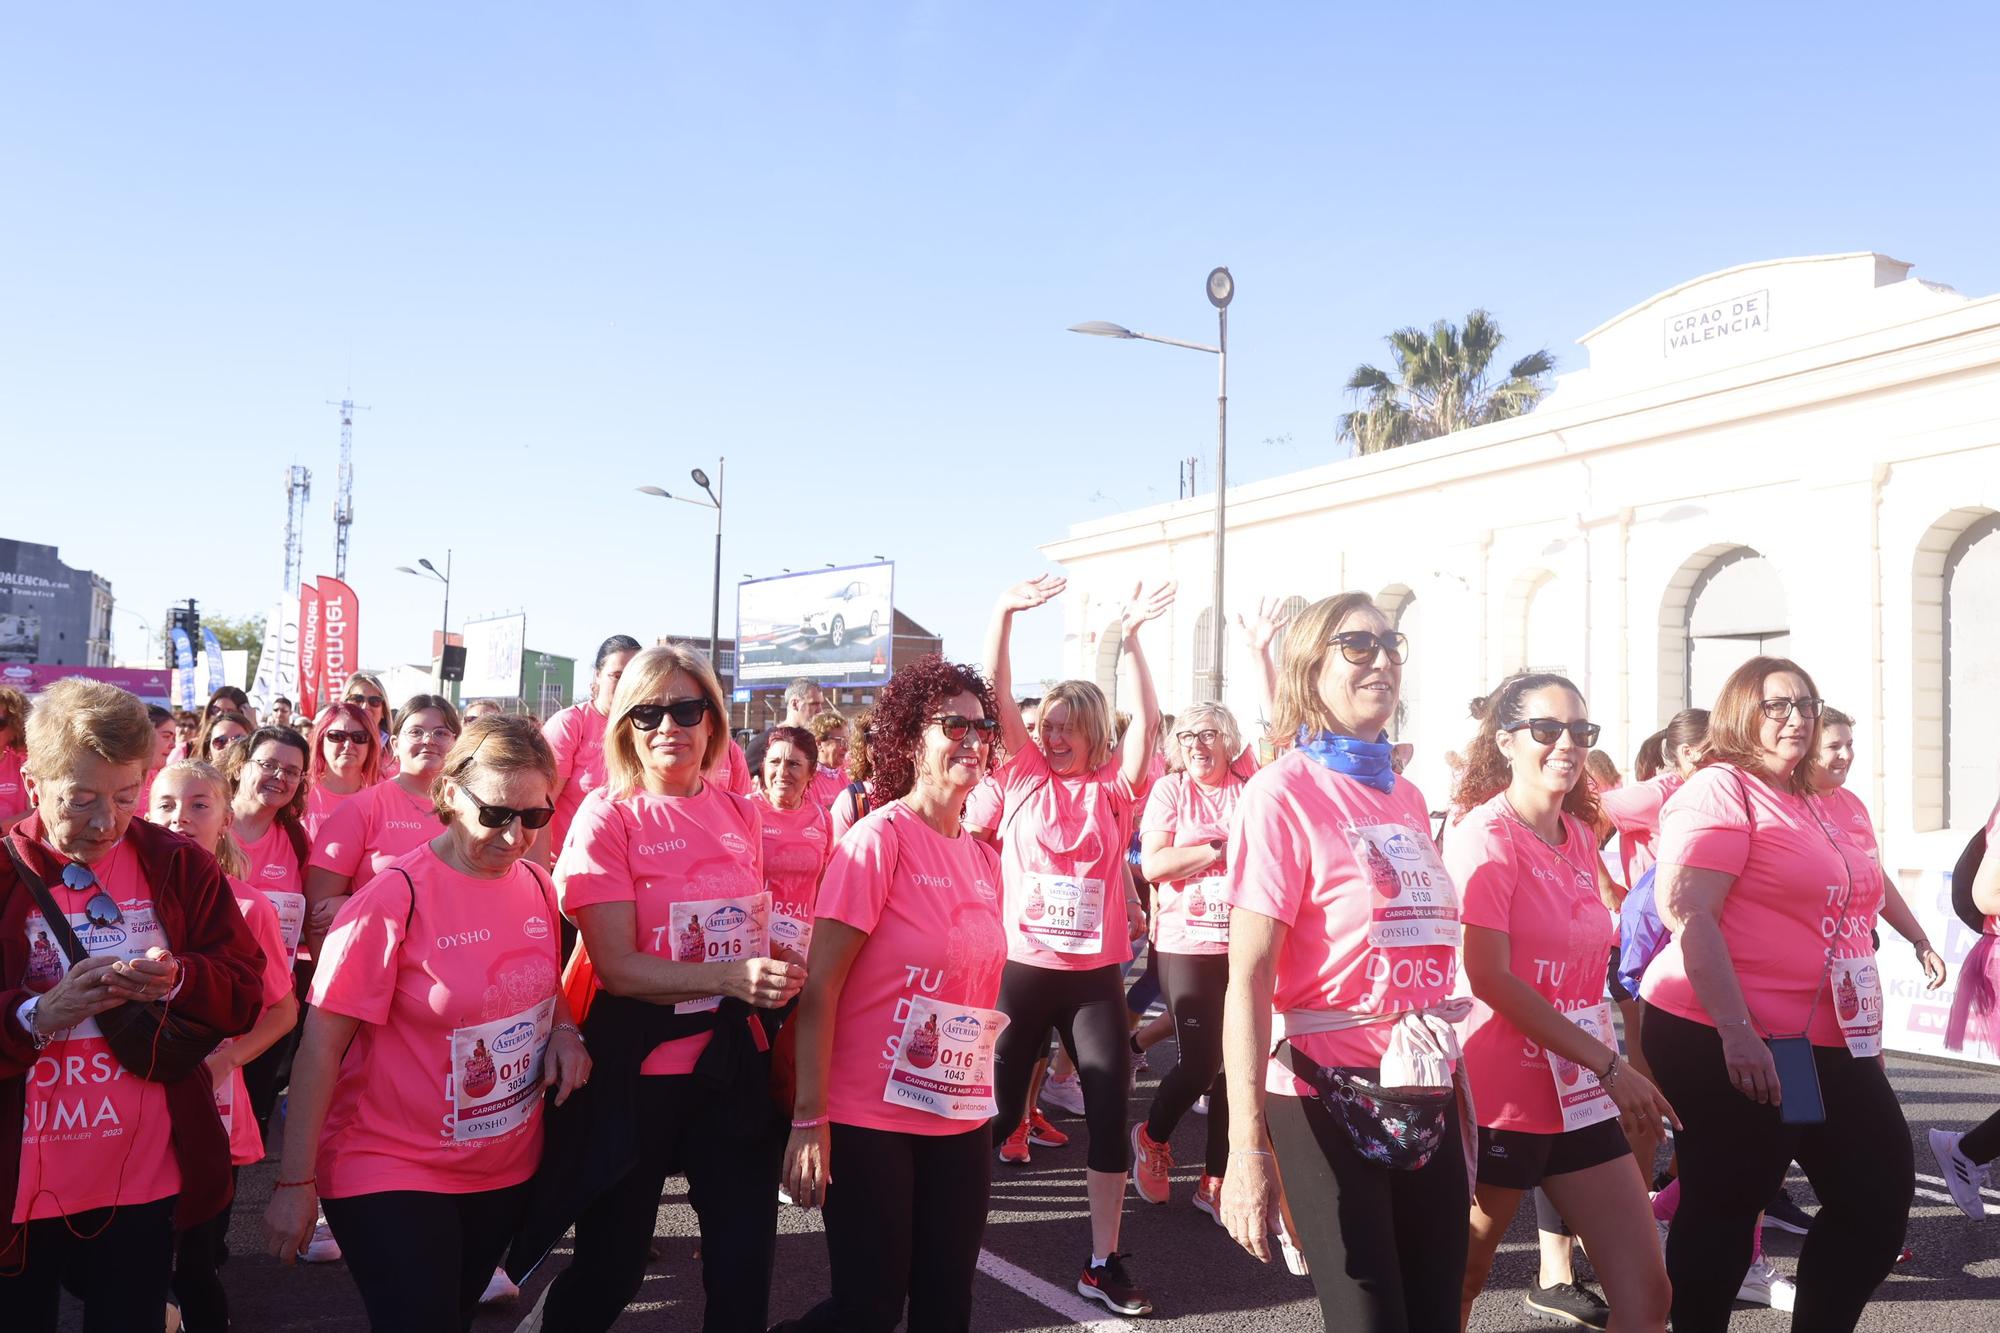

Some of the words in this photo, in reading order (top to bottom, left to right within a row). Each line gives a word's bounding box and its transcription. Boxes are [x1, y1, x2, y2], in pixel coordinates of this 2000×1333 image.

[1674, 310, 1722, 332] GRAO
[1732, 298, 1758, 316] DE
[1670, 315, 1761, 349] VALENCIA
[386, 821, 422, 830] OYSHO
[638, 838, 687, 855] OYSHO
[1401, 870, 1432, 888] 016
[1412, 891, 1432, 902] 6130
[1047, 905, 1075, 918] 016
[1385, 909, 1415, 918] CARRERA
[132, 925, 158, 934] SUMA
[1051, 918, 1070, 927] 2182
[437, 928, 491, 950] OYSHO
[1381, 926, 1420, 938] OYSHO
[708, 938, 742, 957] 016
[905, 965, 944, 993] TU
[1534, 958, 1566, 987] TU
[940, 1048, 974, 1068] 016
[500, 1053, 531, 1081] 016
[944, 1069, 966, 1081] 1043
[507, 1074, 527, 1093] 3034
[905, 1075, 938, 1091] CARRERA
[939, 1084, 949, 1092] DE
[897, 1088, 934, 1105] OYSHO
[472, 1101, 507, 1116] CARRERA
[1570, 1107, 1593, 1121] OYSHO
[102, 1128, 123, 1138] 2023
[468, 1116, 508, 1133] OYSHO
